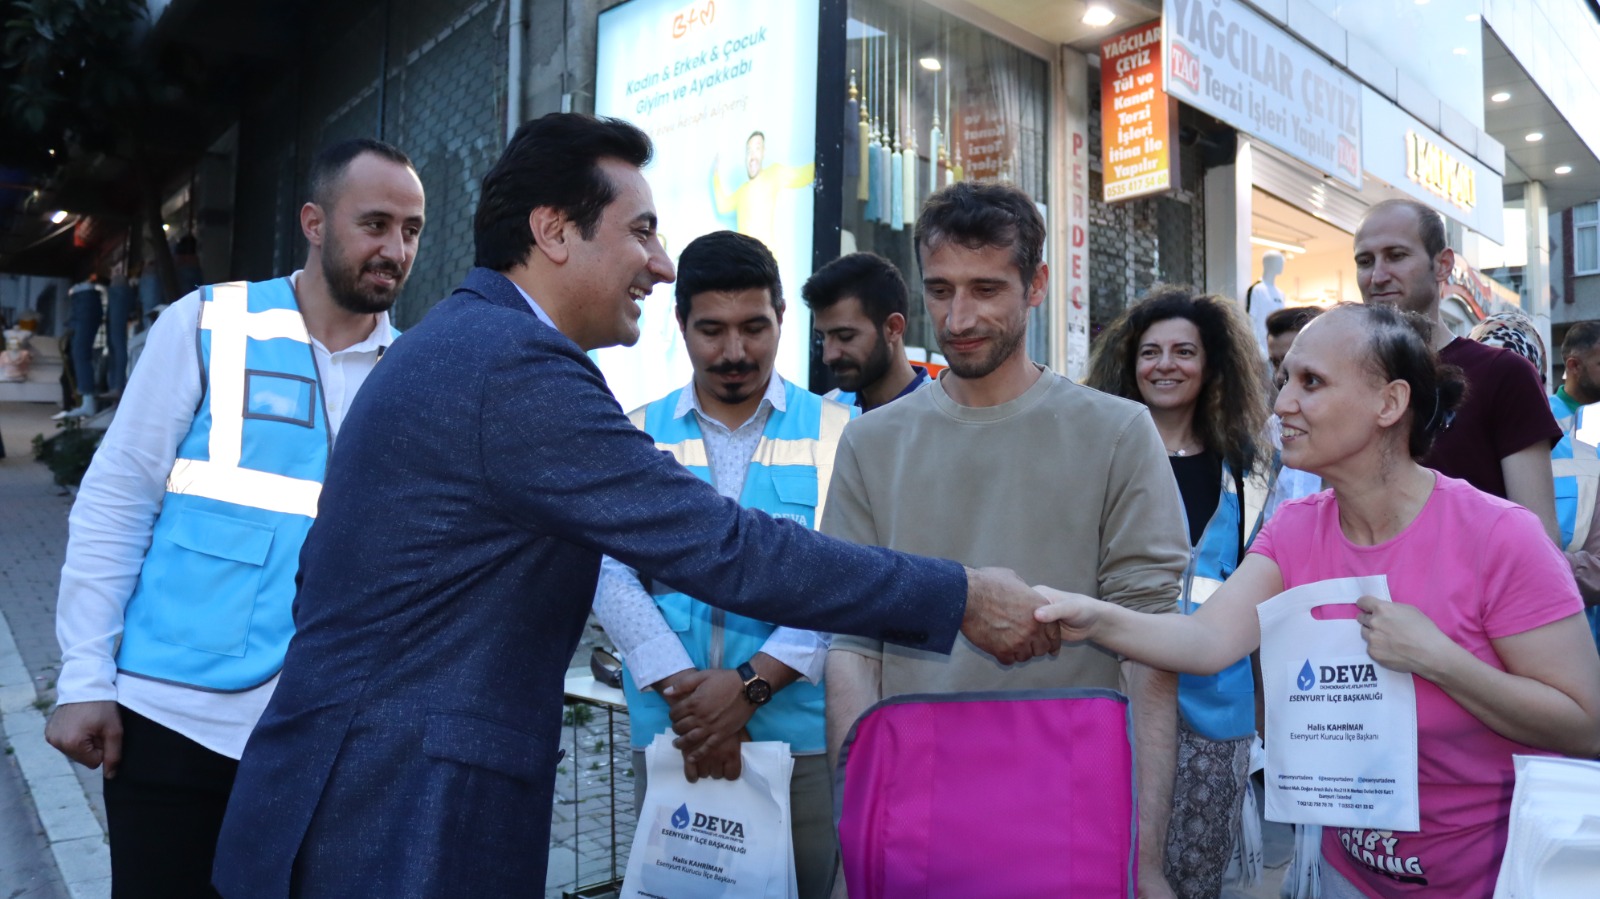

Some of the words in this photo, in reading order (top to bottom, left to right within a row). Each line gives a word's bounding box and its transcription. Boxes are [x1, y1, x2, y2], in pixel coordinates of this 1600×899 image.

[1103, 27, 1162, 60] YAĞCILAR
[626, 73, 659, 96] Kadın
[662, 66, 671, 81] &
[674, 53, 707, 77] Erkek
[710, 46, 719, 62] &
[723, 26, 767, 62] Çocuk
[1116, 49, 1151, 77] ÇEYİZ
[1173, 0, 1294, 101] YAĞCILAR
[1302, 67, 1357, 134] ÇEYİZ
[636, 91, 670, 116] Giyim
[673, 84, 687, 100] ve
[689, 60, 753, 96] Ayakkabı
[1113, 75, 1134, 94] Tül
[1137, 72, 1154, 86] ve
[1114, 88, 1155, 110] Kanat
[1118, 105, 1151, 126] Terzi
[1203, 64, 1243, 114] Terzi
[1292, 114, 1336, 162] Yapılır
[1113, 157, 1158, 179] Yapılır
[1107, 183, 1126, 198] 0535
[1128, 179, 1142, 193] 417
[1319, 664, 1378, 684] DEVA
[1289, 694, 1325, 702] ESENYURT
[1327, 693, 1342, 703] İLÇE
[1343, 692, 1383, 703] BAŞKANLIĞI
[1290, 732, 1319, 741] Esenyurt
[1320, 733, 1344, 741] Kurucu
[1345, 732, 1355, 741] İlçe
[1357, 733, 1379, 741] Başkanı
[1327, 723, 1364, 731] KAHRİMAN
[692, 812, 745, 838] DEVA
[661, 828, 693, 841] ESENYURT
[694, 836, 707, 846] İLÇE
[708, 841, 747, 855] BAŞKANLIĞI
[656, 859, 681, 871] Esenyurt
[682, 865, 702, 876] Kurucu
[714, 874, 737, 885] Başkanı
[672, 855, 688, 865] Halis
[688, 860, 723, 873] KAHRİMAN
